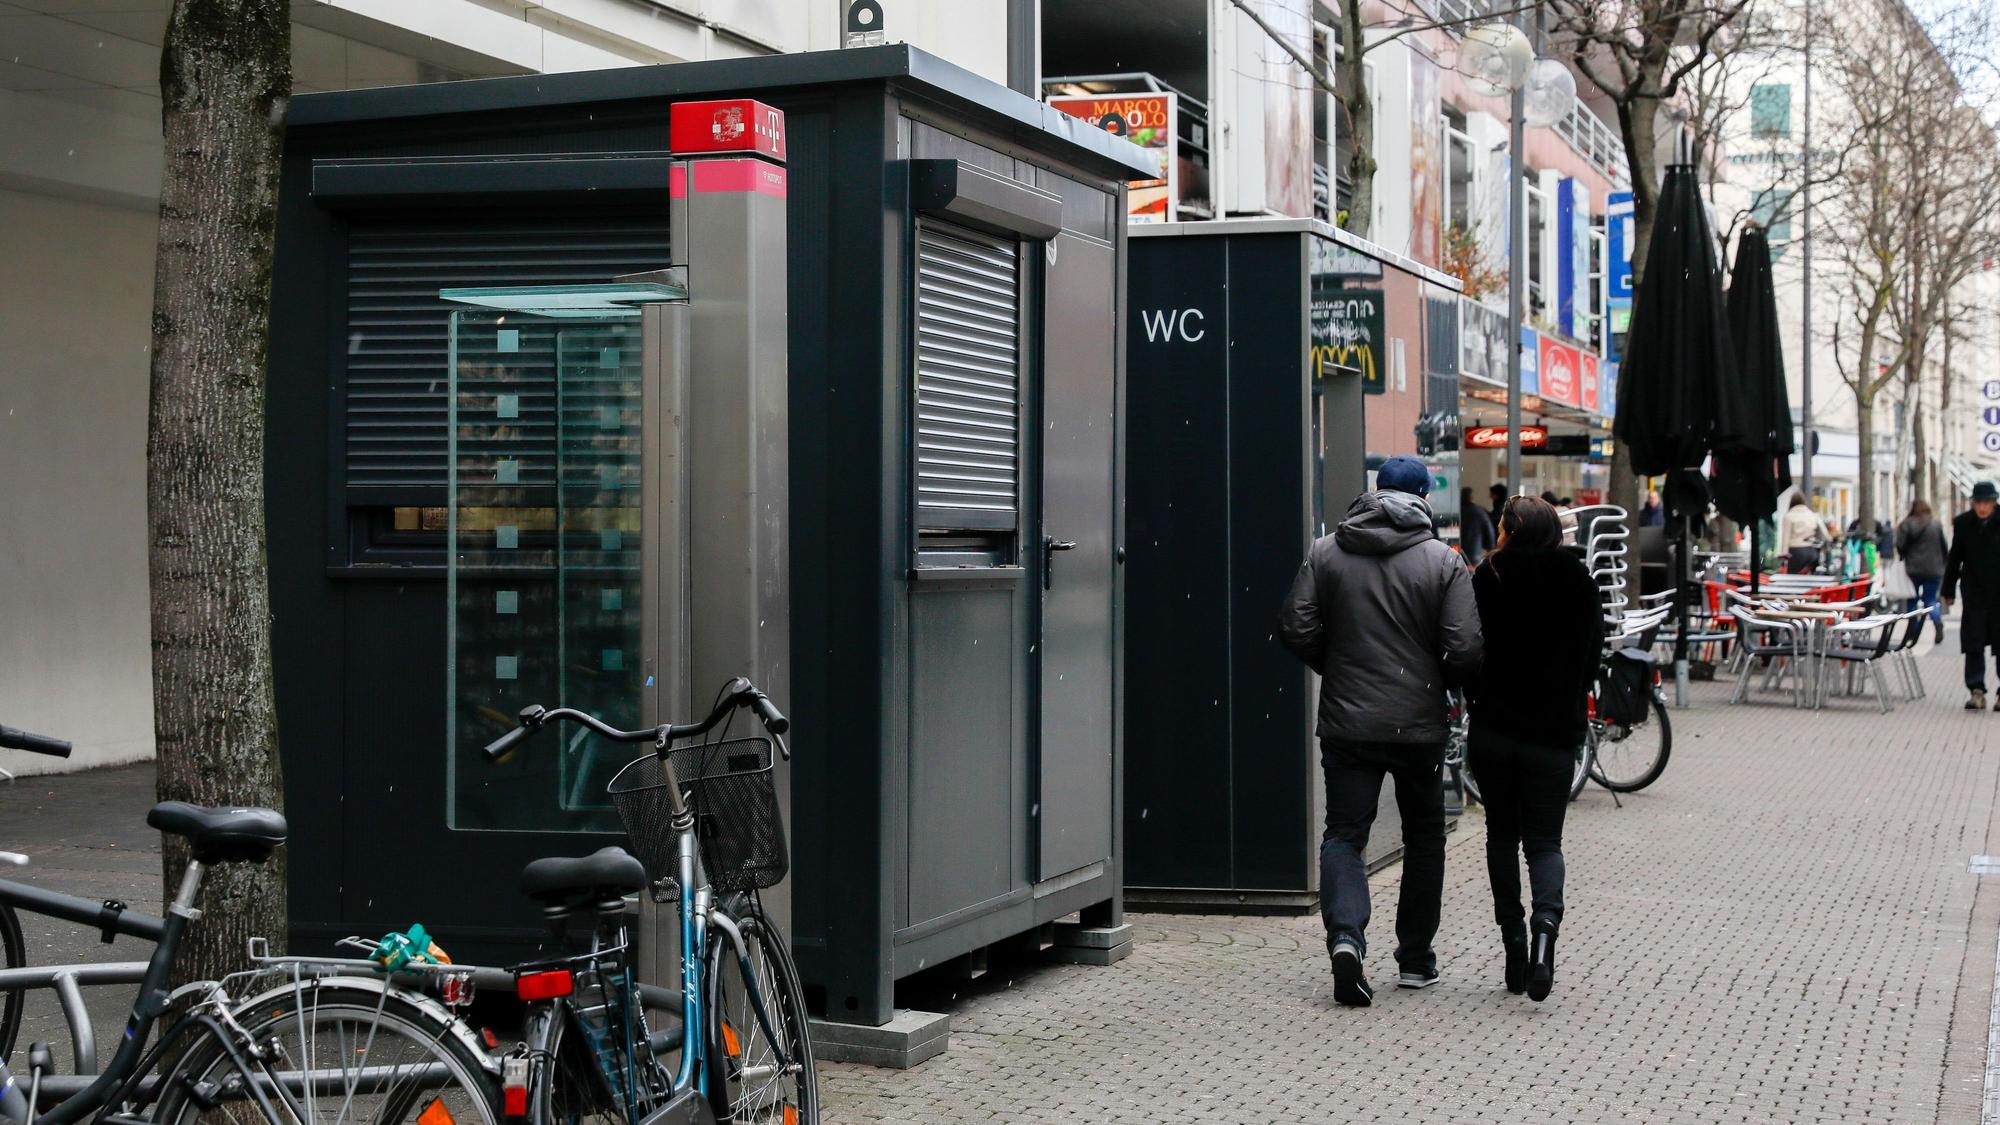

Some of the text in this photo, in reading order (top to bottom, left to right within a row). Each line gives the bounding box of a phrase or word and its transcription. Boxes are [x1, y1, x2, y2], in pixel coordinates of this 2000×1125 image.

[1093, 99, 1161, 117] MARCO
[1127, 109, 1167, 128] OLO
[1141, 308, 1205, 342] WC
